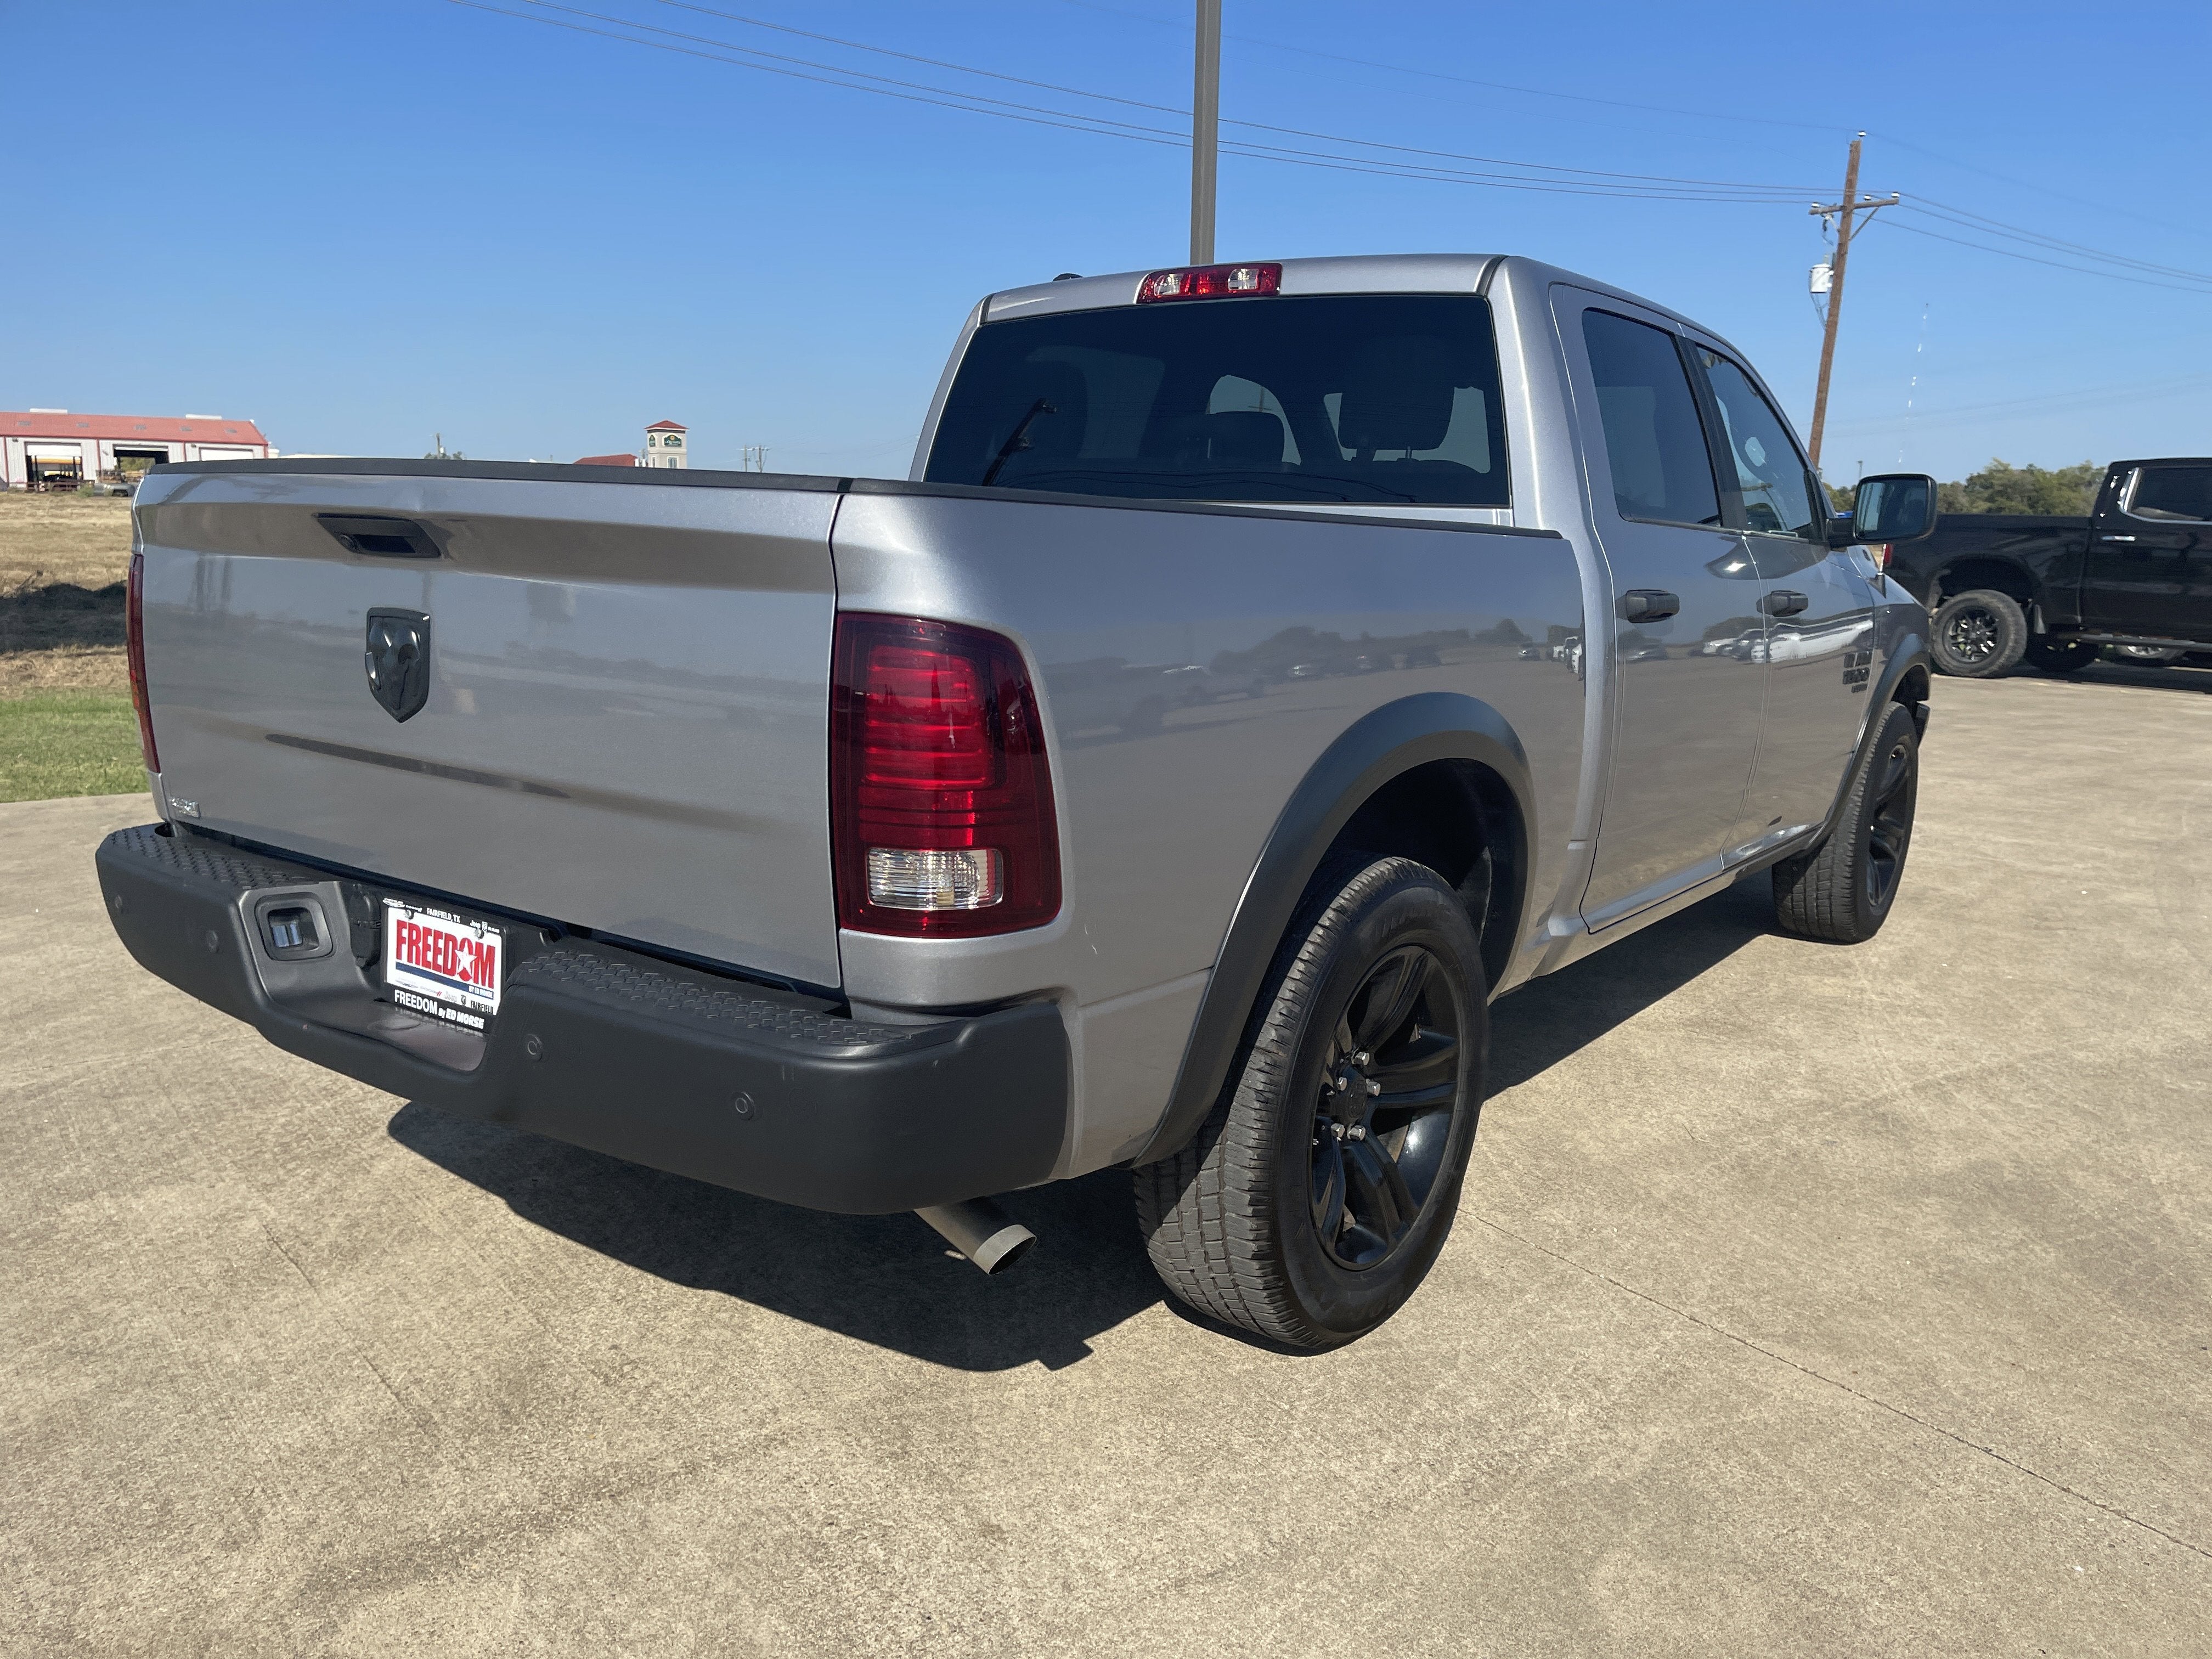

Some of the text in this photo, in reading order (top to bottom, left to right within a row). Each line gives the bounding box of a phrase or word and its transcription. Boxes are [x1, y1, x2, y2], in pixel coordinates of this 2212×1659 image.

[453, 913, 460, 923] TX
[396, 919, 495, 989] FREEDOM
[394, 989, 438, 1015] FREEDOM
[446, 1008, 456, 1020] ED
[456, 1012, 484, 1029] MORSE
[470, 1000, 494, 1014] FAIRFIELD
